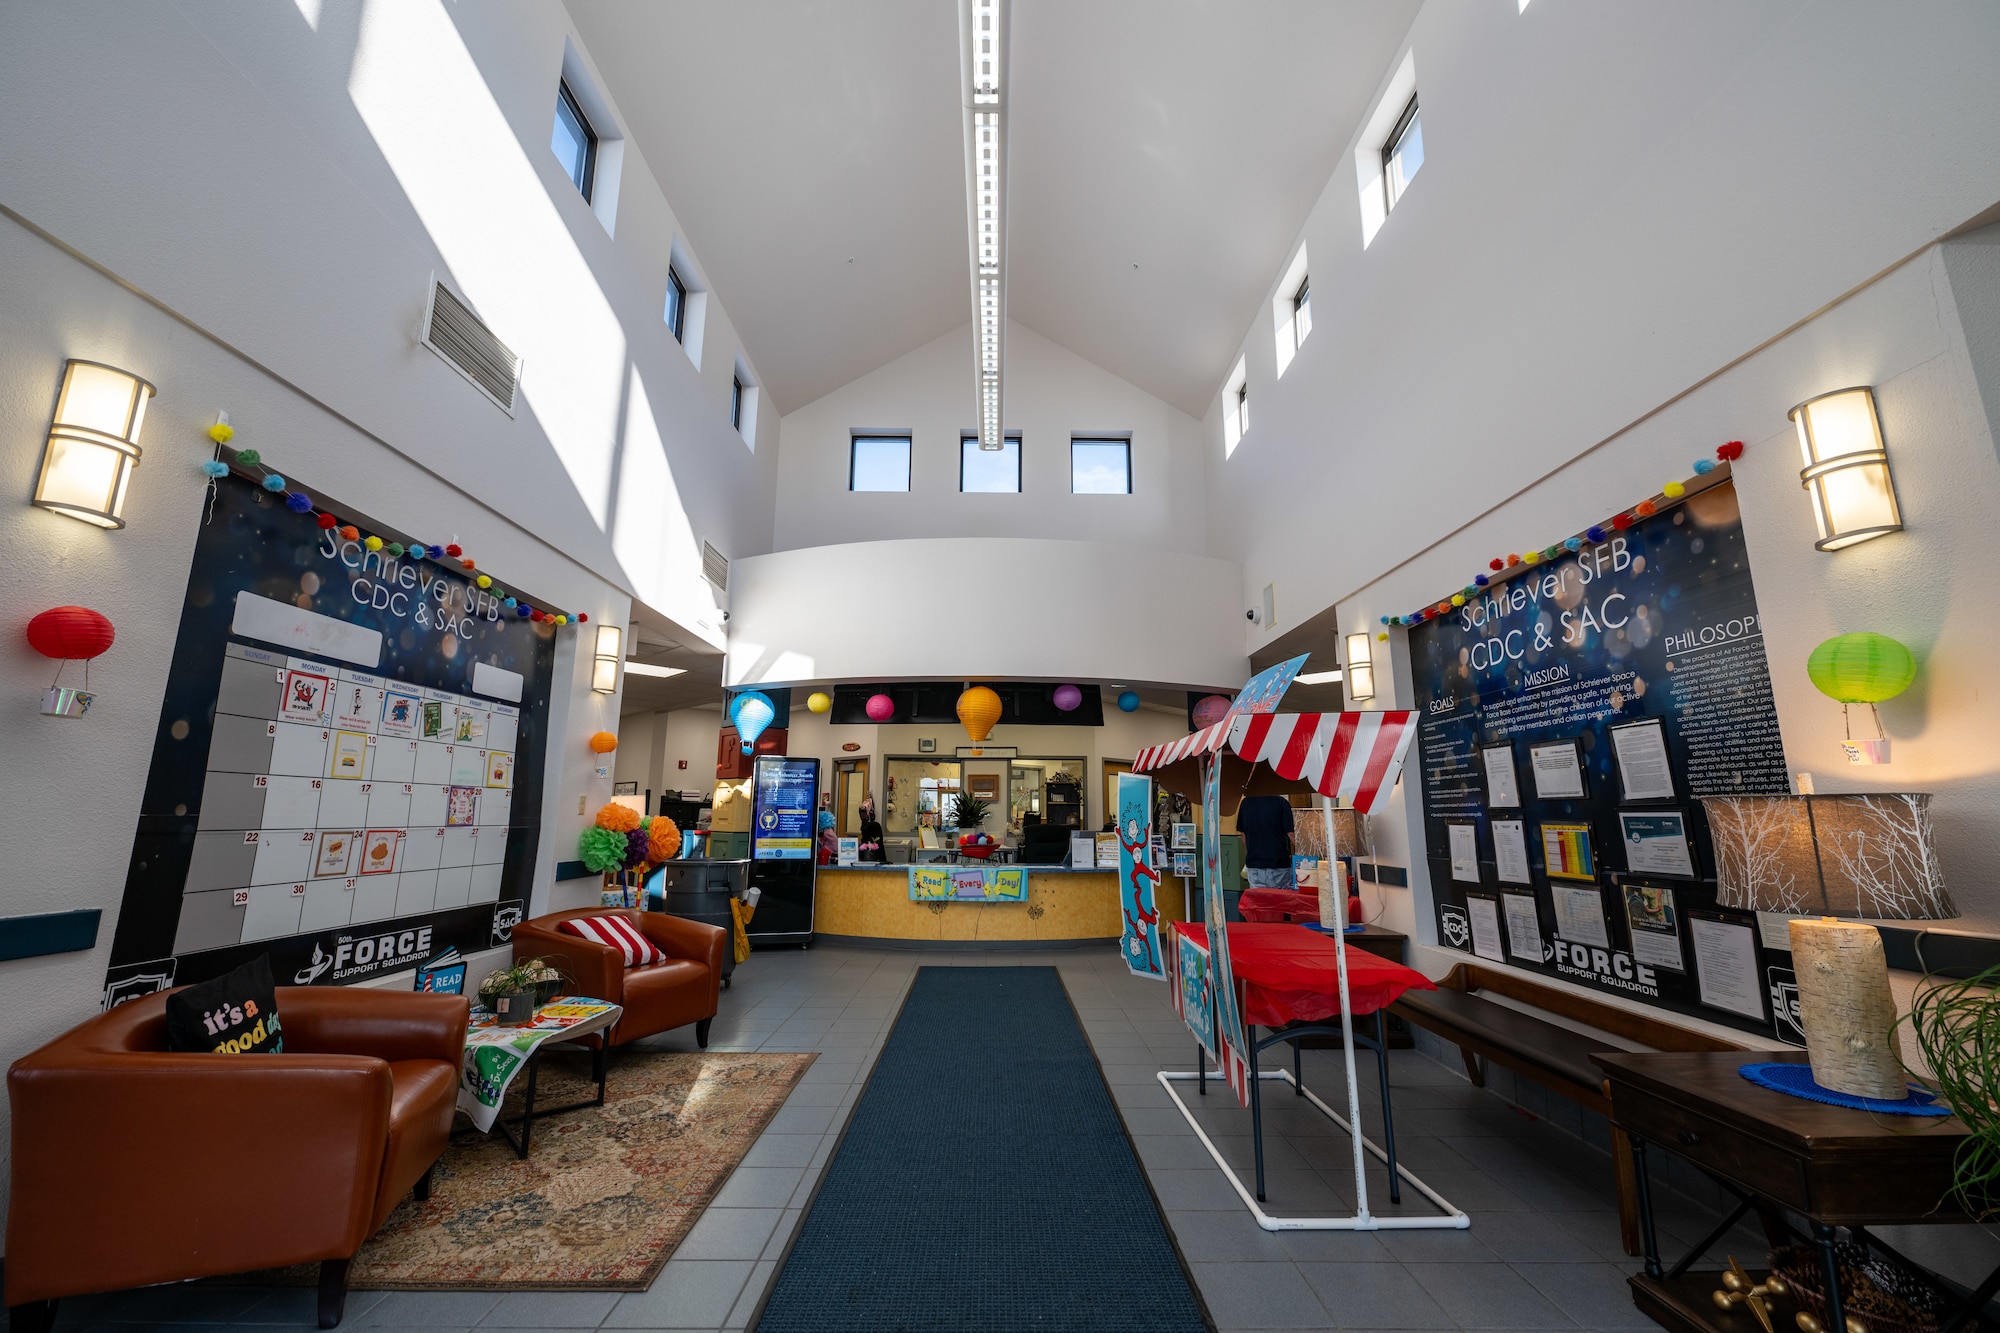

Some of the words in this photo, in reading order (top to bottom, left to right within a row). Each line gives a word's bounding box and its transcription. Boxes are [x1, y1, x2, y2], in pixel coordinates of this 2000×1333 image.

[319, 528, 459, 606] Schriever
[463, 585, 499, 622] SFB
[1461, 566, 1569, 633] Schriever
[1577, 537, 1631, 585] SFB
[351, 577, 409, 617] CDC
[414, 601, 429, 626] &
[435, 608, 475, 640] SAC
[1471, 629, 1525, 671] CDC
[1534, 622, 1554, 652] &
[1560, 593, 1629, 644] SAC
[1674, 661, 1710, 673] Development
[1711, 656, 1738, 666] Programs
[1692, 653, 1716, 663] practice
[244, 649, 272, 662] SUNDAY
[301, 662, 327, 674] MONDAY
[352, 673, 374, 684] TUESDAY
[391, 682, 419, 694] WEDNESDAY
[432, 691, 453, 701] THURSDAY
[469, 699, 482, 707] FRIDAY
[497, 705, 513, 713] SATURDAY
[1524, 664, 1569, 685] MISSION
[1671, 672, 1690, 681] current
[1690, 667, 1720, 677] knowledge
[1699, 672, 1728, 682] childhood
[1729, 666, 1763, 677] education.
[278, 671, 283, 680] 1
[330, 682, 335, 691] 2
[378, 691, 384, 699] 3
[1489, 700, 1506, 710] support
[1506, 698, 1516, 706] and
[1517, 692, 1540, 702] enhance
[1540, 690, 1550, 698] the
[1552, 686, 1572, 696] mission
[1572, 682, 1580, 690] of
[1580, 676, 1611, 689] Schriever
[1612, 671, 1636, 682] Space
[1670, 686, 1699, 695] responsible
[1708, 679, 1739, 688] supporting
[1727, 683, 1754, 692] meaning
[1429, 695, 1455, 712] GOALS
[1486, 711, 1500, 719] Force
[1500, 708, 1512, 716] Base
[1512, 702, 1540, 714] community
[1540, 700, 1548, 708] by
[1549, 694, 1576, 707] providing
[1674, 698, 1710, 708] development
[1722, 690, 1756, 700] considered
[1695, 704, 1716, 712] equally
[1494, 716, 1516, 726] enriching
[1516, 710, 1548, 722] environment
[1570, 702, 1594, 712] children
[1604, 697, 1616, 705] our
[1618, 692, 1640, 702] active
[1677, 712, 1717, 722] acknowledges
[1730, 706, 1755, 714] children
[1508, 724, 1526, 732] military
[1526, 720, 1552, 729] members
[1552, 716, 1564, 724] and
[1565, 712, 1586, 722] civilian
[1588, 707, 1622, 720] personnel.
[268, 725, 275, 733] 8
[322, 731, 328, 740] 9
[368, 736, 377, 744] 10
[255, 777, 267, 786] 15
[311, 780, 321, 788] 16
[361, 784, 372, 793] 17
[404, 784, 412, 792] 18
[442, 786, 449, 794] 19
[245, 832, 259, 842] 22
[302, 832, 314, 841] 23
[354, 830, 363, 838] 24
[398, 830, 407, 838] 25
[437, 828, 445, 836] 26
[471, 828, 479, 836] 27
[235, 892, 248, 902] 29
[293, 884, 304, 894] 30
[346, 879, 356, 888] 31
[922, 875, 942, 887] Read
[958, 879, 982, 889] Every
[1001, 877, 1020, 889] Day!
[1448, 922, 1463, 934] CDC
[338, 935, 353, 944] 50th
[334, 928, 433, 970] FORCE
[333, 962, 380, 979] SUPPORT
[382, 950, 430, 968] SQUADRON
[1185, 953, 1197, 979] Hats
[1554, 940, 1657, 987] FORCE
[436, 973, 462, 988] READ
[1557, 963, 1597, 981] SUPPORT
[1600, 975, 1658, 997] SQUADRON
[203, 1002, 244, 1036] it's
[244, 1000, 258, 1018] a
[491, 1053, 501, 1063] By
[496, 1054, 515, 1071] Seuss
[493, 1070, 502, 1083] Dr.
